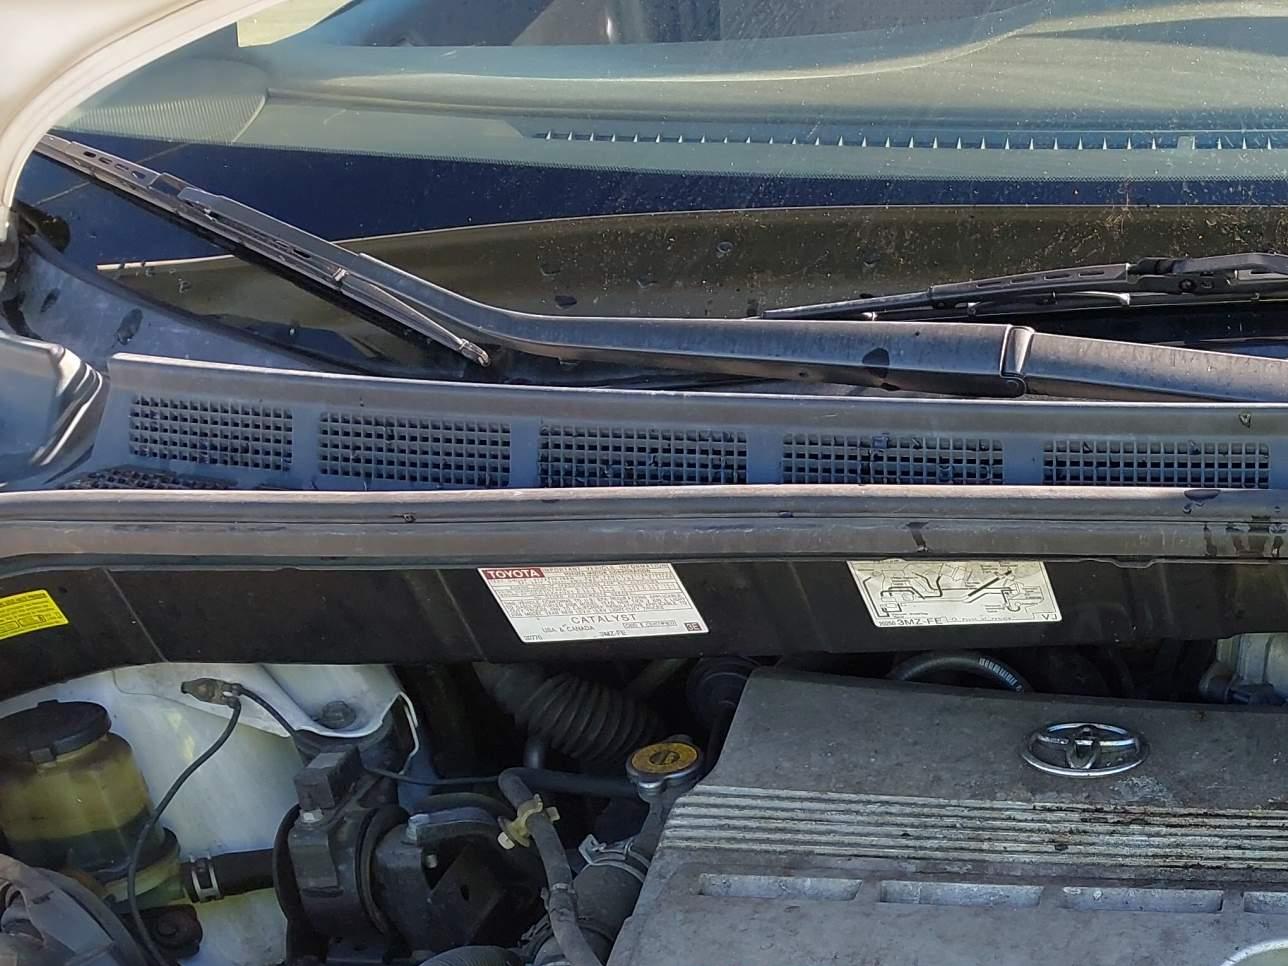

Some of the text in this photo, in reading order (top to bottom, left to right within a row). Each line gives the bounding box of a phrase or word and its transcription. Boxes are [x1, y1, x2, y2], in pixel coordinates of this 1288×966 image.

[488, 569, 540, 579] TOYOTA
[571, 614, 637, 624] CATALYST
[897, 617, 942, 626] 3MZ-FE
[566, 624, 594, 632] CANADA
